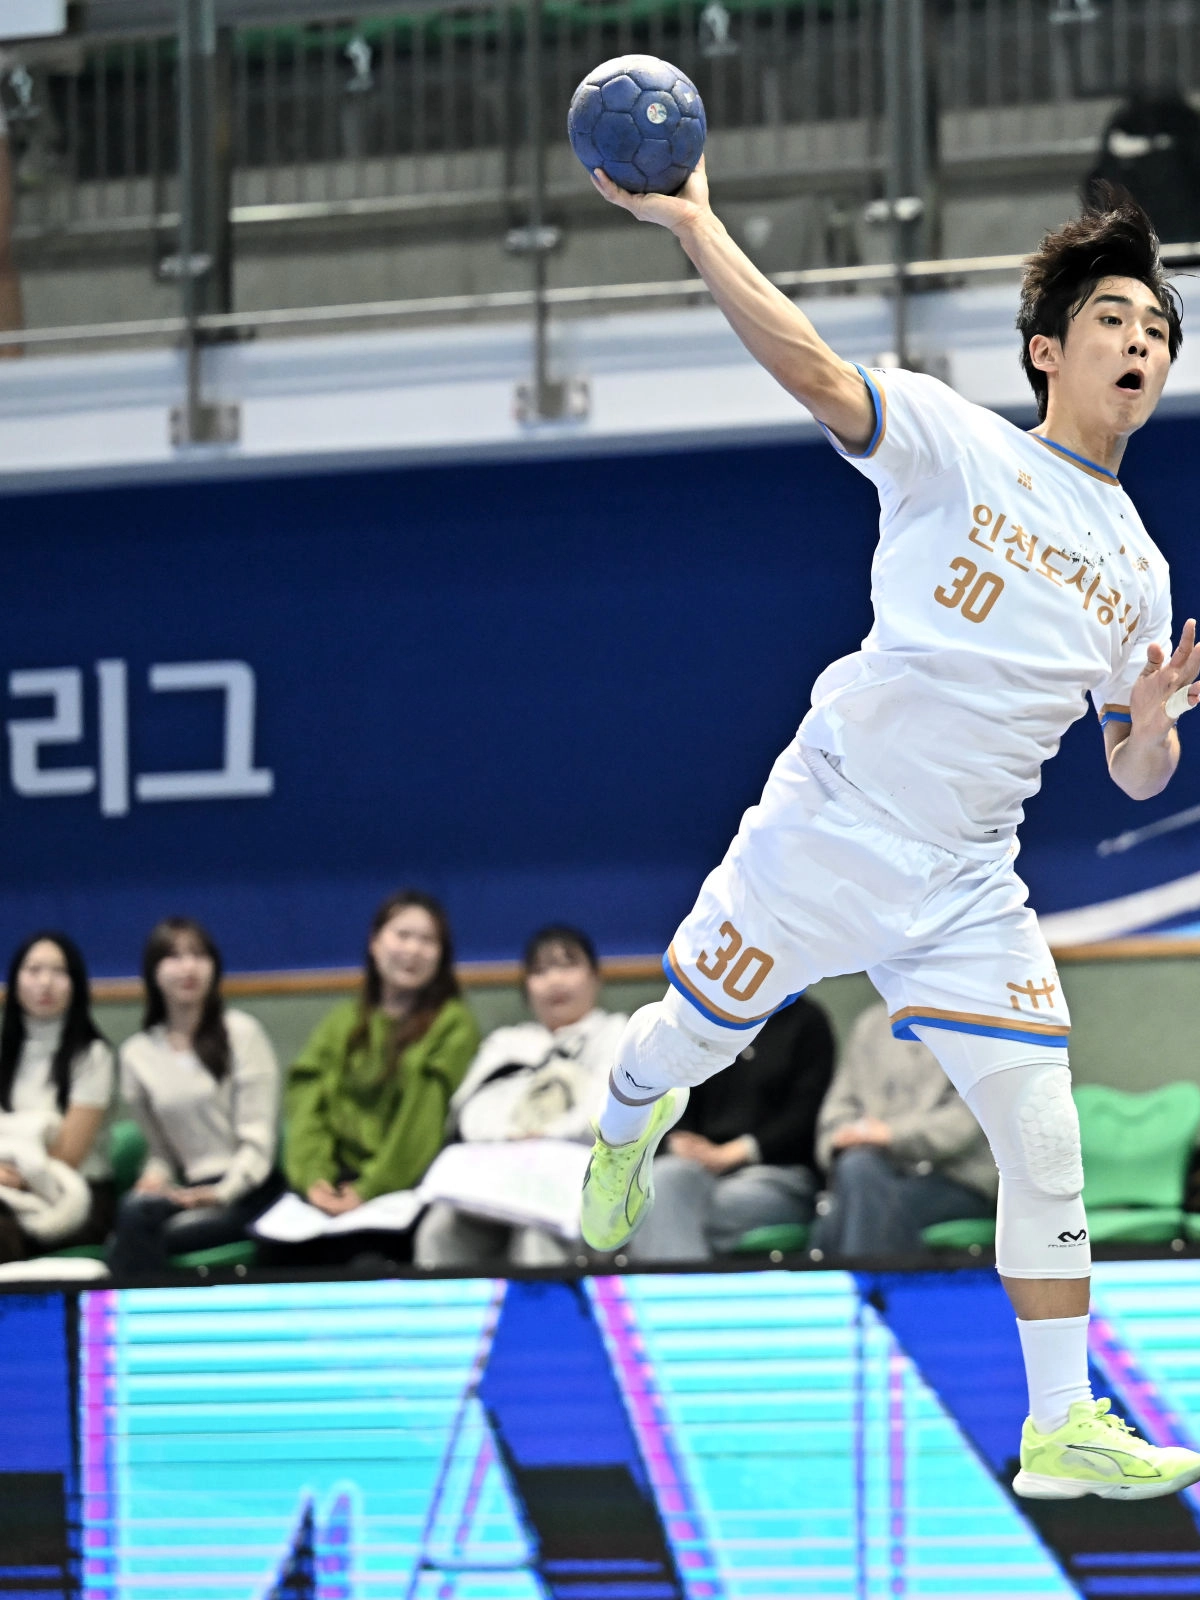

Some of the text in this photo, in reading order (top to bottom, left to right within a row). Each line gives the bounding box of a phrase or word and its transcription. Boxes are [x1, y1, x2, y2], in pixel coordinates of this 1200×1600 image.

[934, 556, 1005, 624] 30
[7, 656, 275, 818] 리그
[695, 920, 775, 1002] 30
